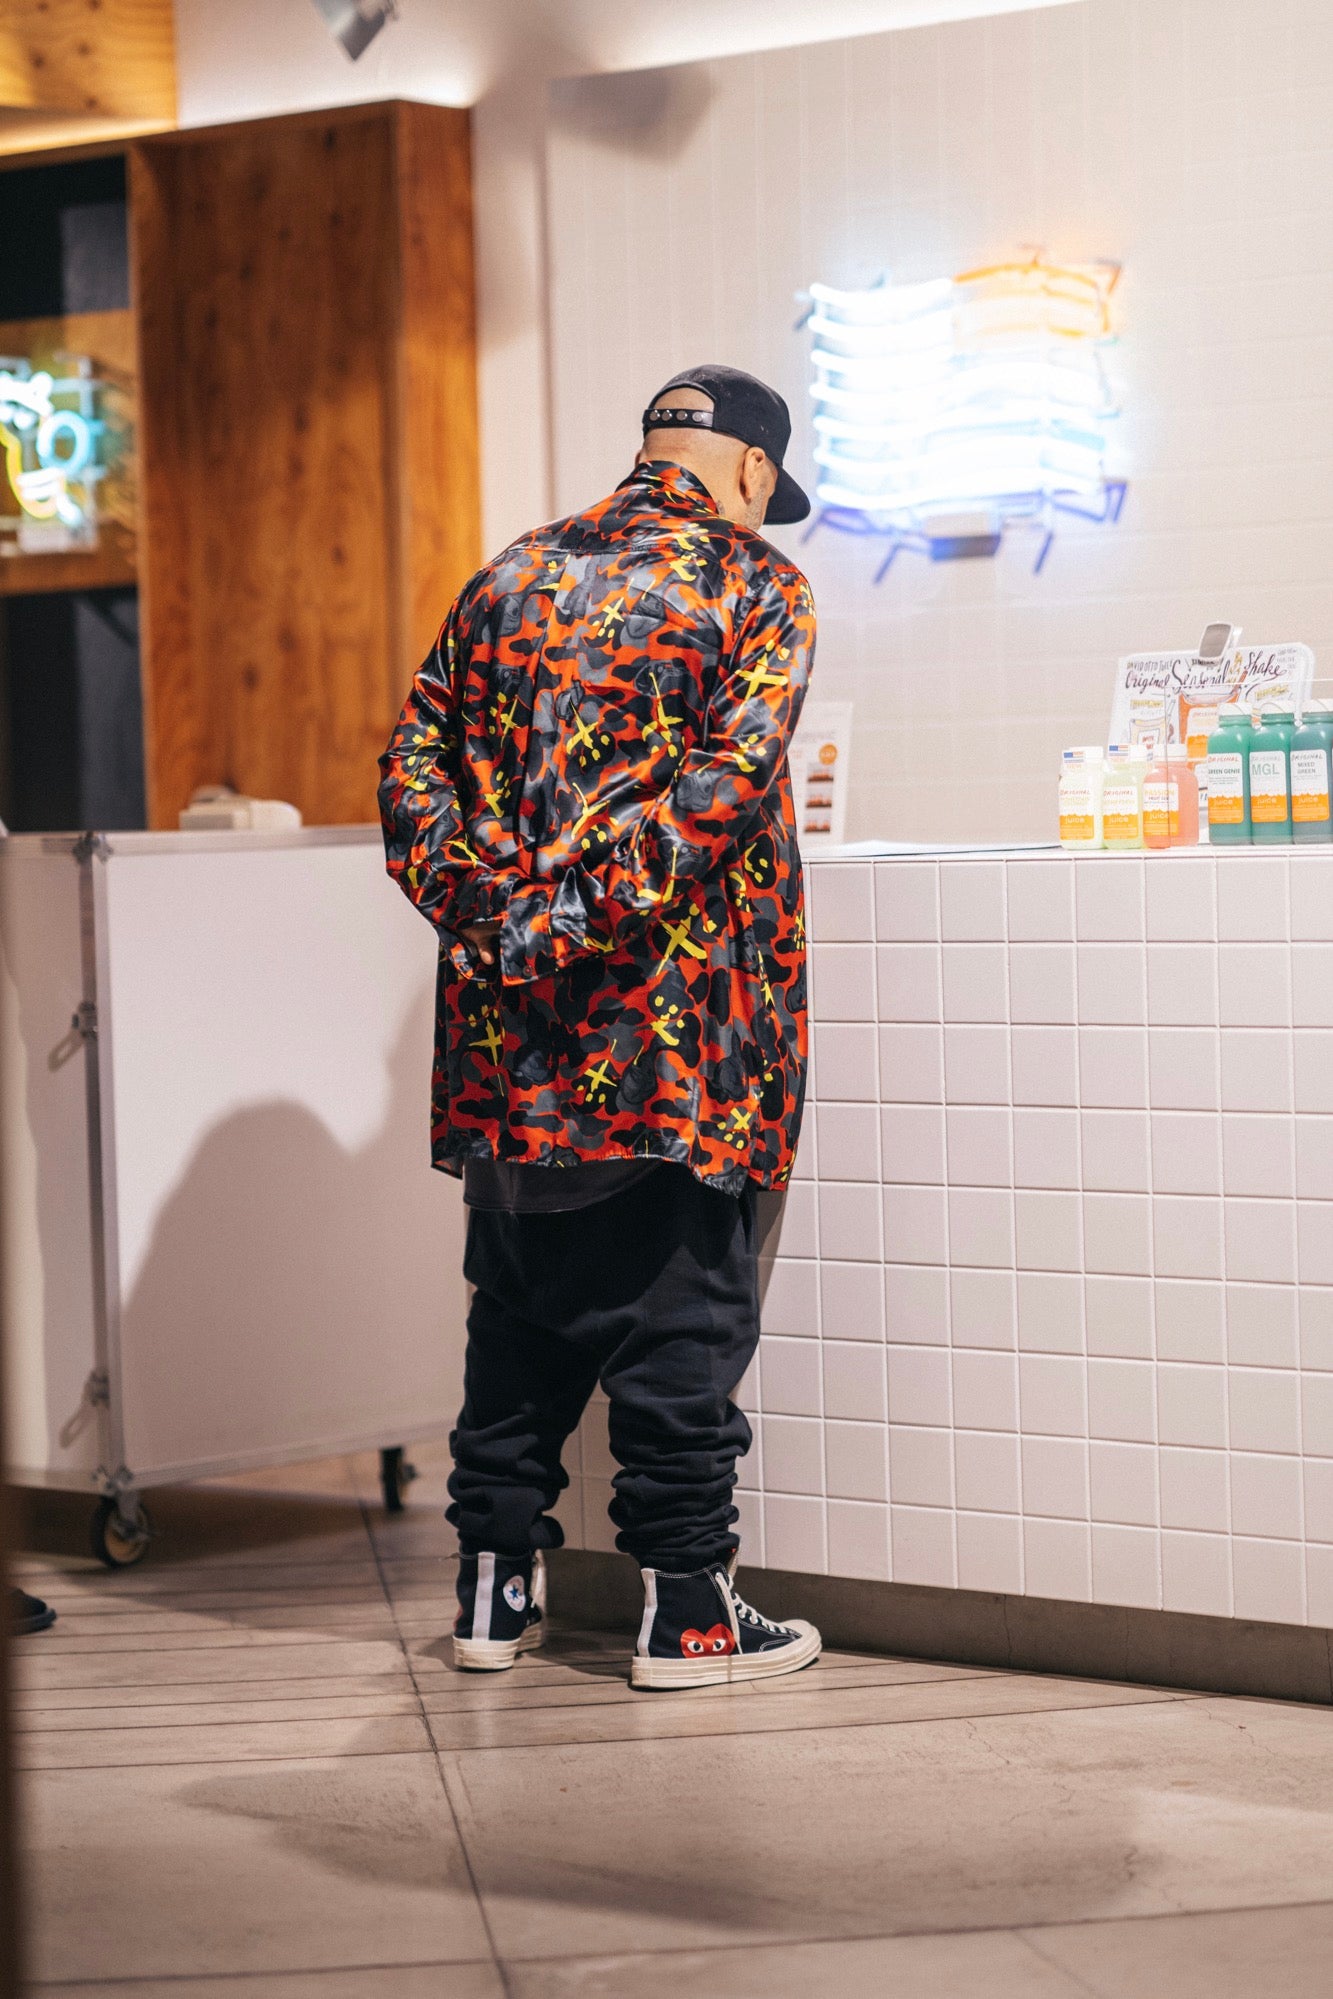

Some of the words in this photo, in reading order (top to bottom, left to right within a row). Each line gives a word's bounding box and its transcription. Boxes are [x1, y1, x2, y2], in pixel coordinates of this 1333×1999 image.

[1125, 671, 1170, 694] Original
[1243, 651, 1286, 682] Shake
[1251, 763, 1280, 776] MGL
